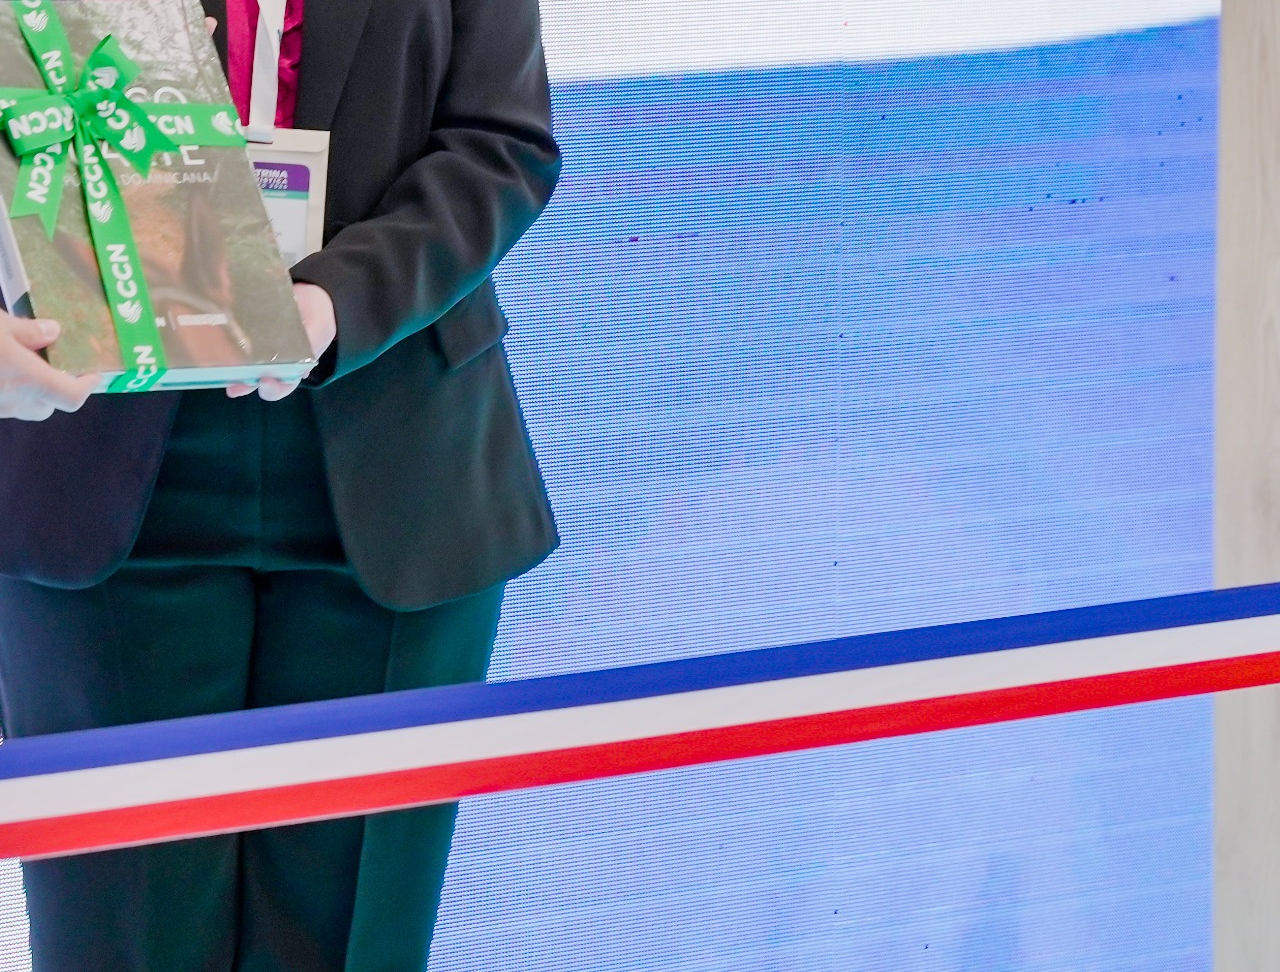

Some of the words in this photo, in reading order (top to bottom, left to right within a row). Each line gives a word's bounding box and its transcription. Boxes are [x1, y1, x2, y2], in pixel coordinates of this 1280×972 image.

[26, 153, 54, 204] CCN
[83, 144, 108, 199] CCN
[106, 243, 138, 299] CCN
